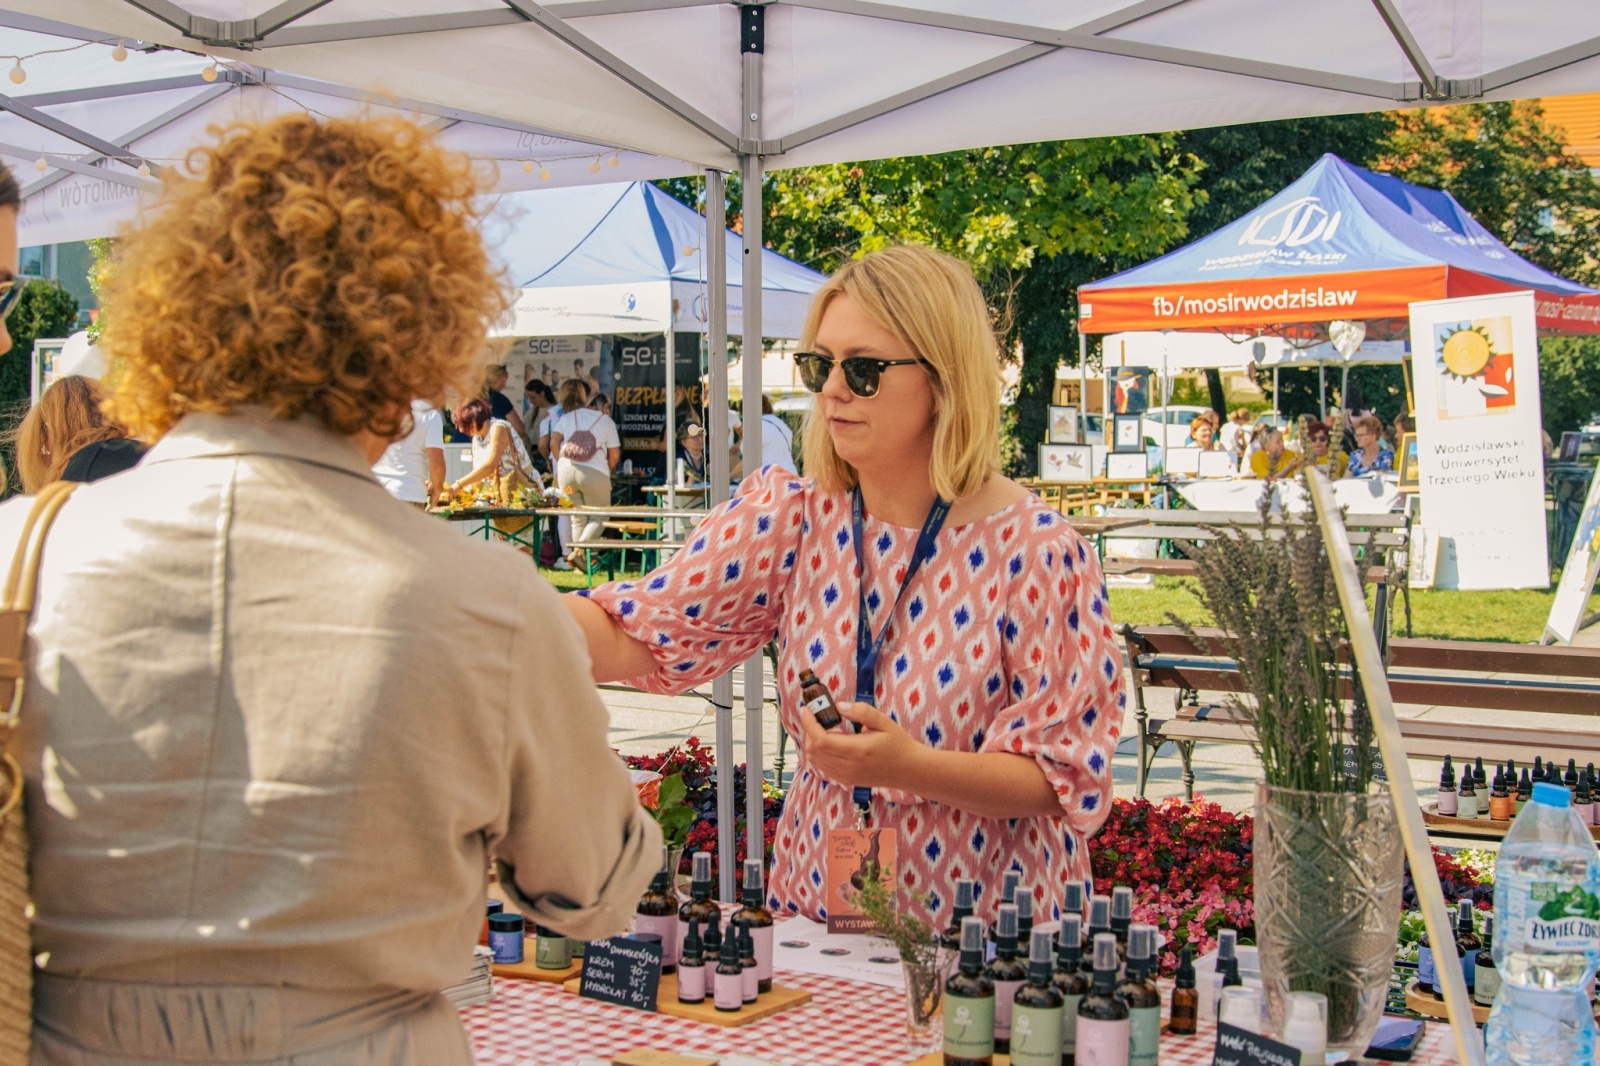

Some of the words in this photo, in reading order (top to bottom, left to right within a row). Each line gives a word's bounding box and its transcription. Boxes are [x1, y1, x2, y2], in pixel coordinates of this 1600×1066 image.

[1152, 287, 1357, 316] fb/mosirwodzislaw
[615, 386, 699, 406] BEZPŁNE
[623, 413, 648, 422] SZKOŁY
[621, 424, 663, 432] WODZISŁAW
[1441, 454, 1519, 470] Uniwersytet
[1427, 473, 1490, 486] Trzeciego
[1494, 468, 1536, 481] Wieku
[835, 920, 884, 929] WYSTAW
[1531, 920, 1575, 940] ŻYWIEC
[589, 956, 614, 969] KREM
[586, 967, 615, 983] SERUM
[585, 981, 627, 999] HYDROLAT
